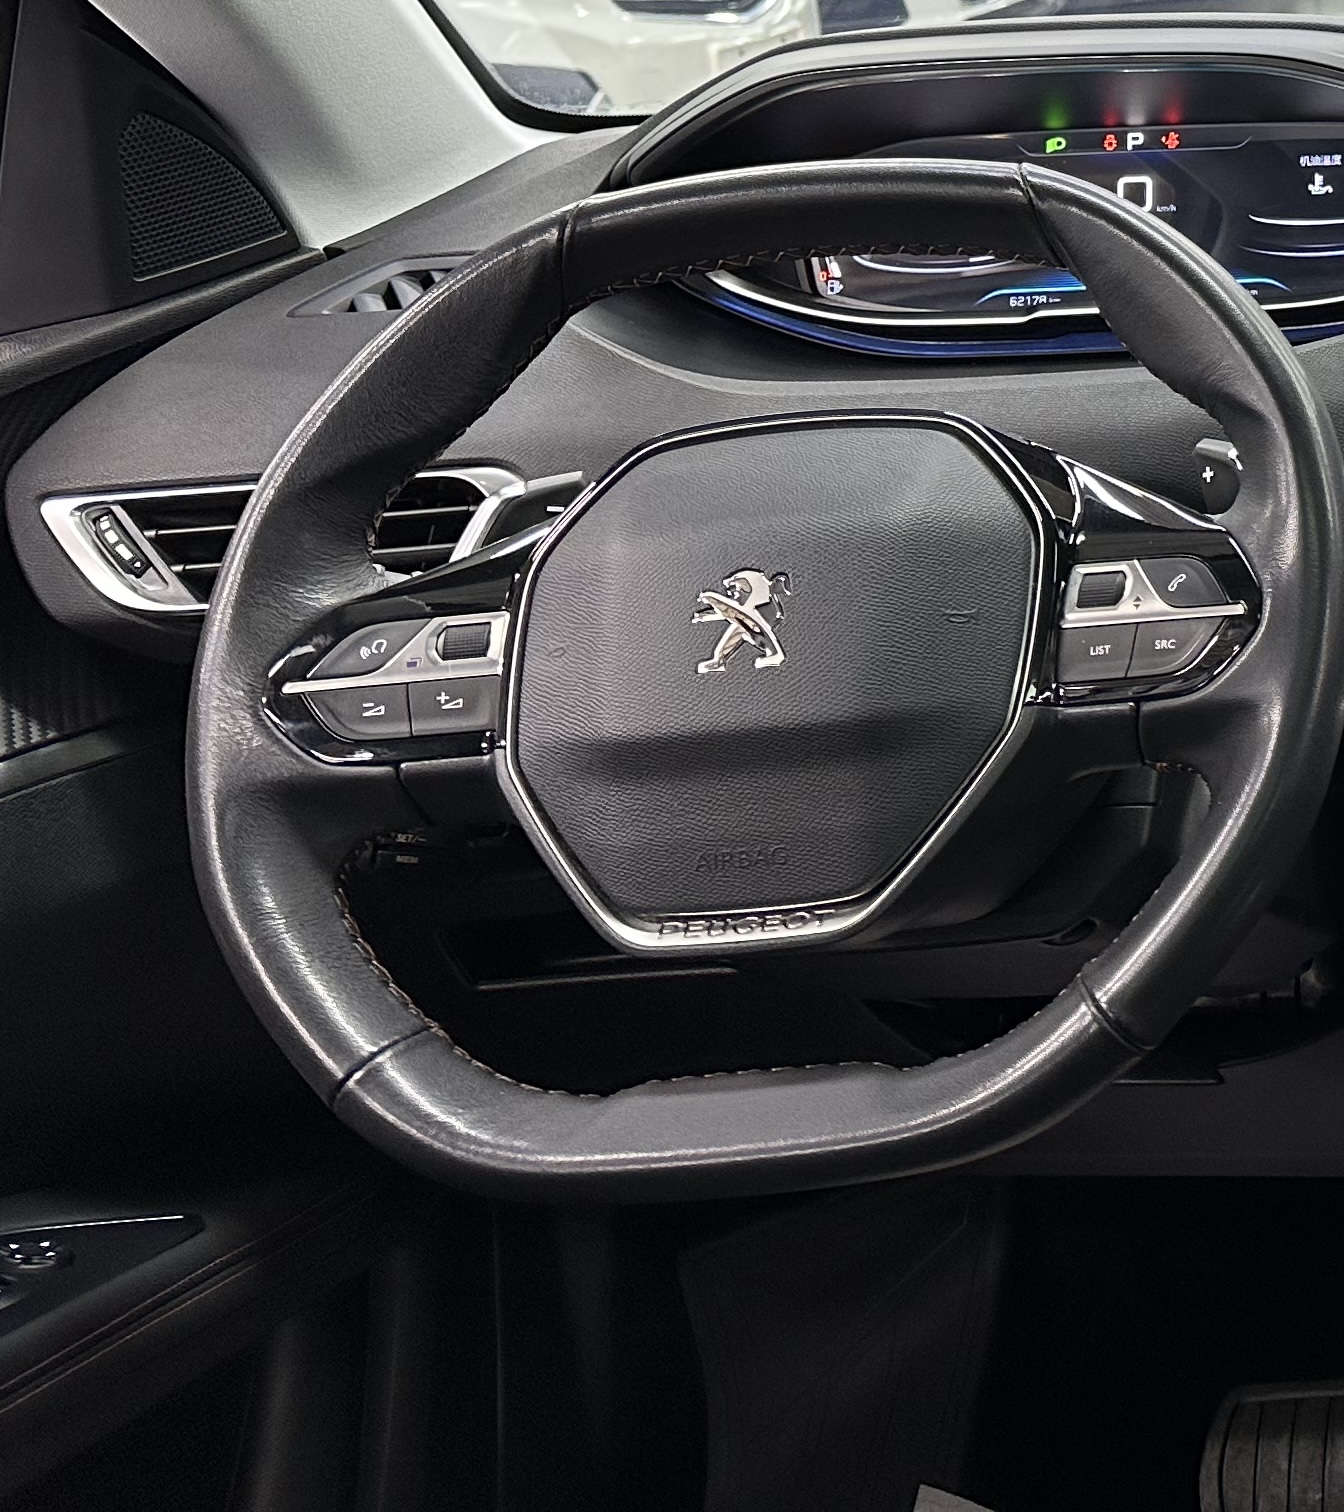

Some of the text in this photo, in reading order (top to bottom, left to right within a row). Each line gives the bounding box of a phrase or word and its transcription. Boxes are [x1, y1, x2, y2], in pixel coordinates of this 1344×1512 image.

[1127, 132, 1144, 150] P
[1089, 644, 1112, 656] LIST
[1154, 639, 1177, 650] SRC
[694, 845, 789, 872] AIRBAG
[656, 909, 836, 940] PEUGEOT
